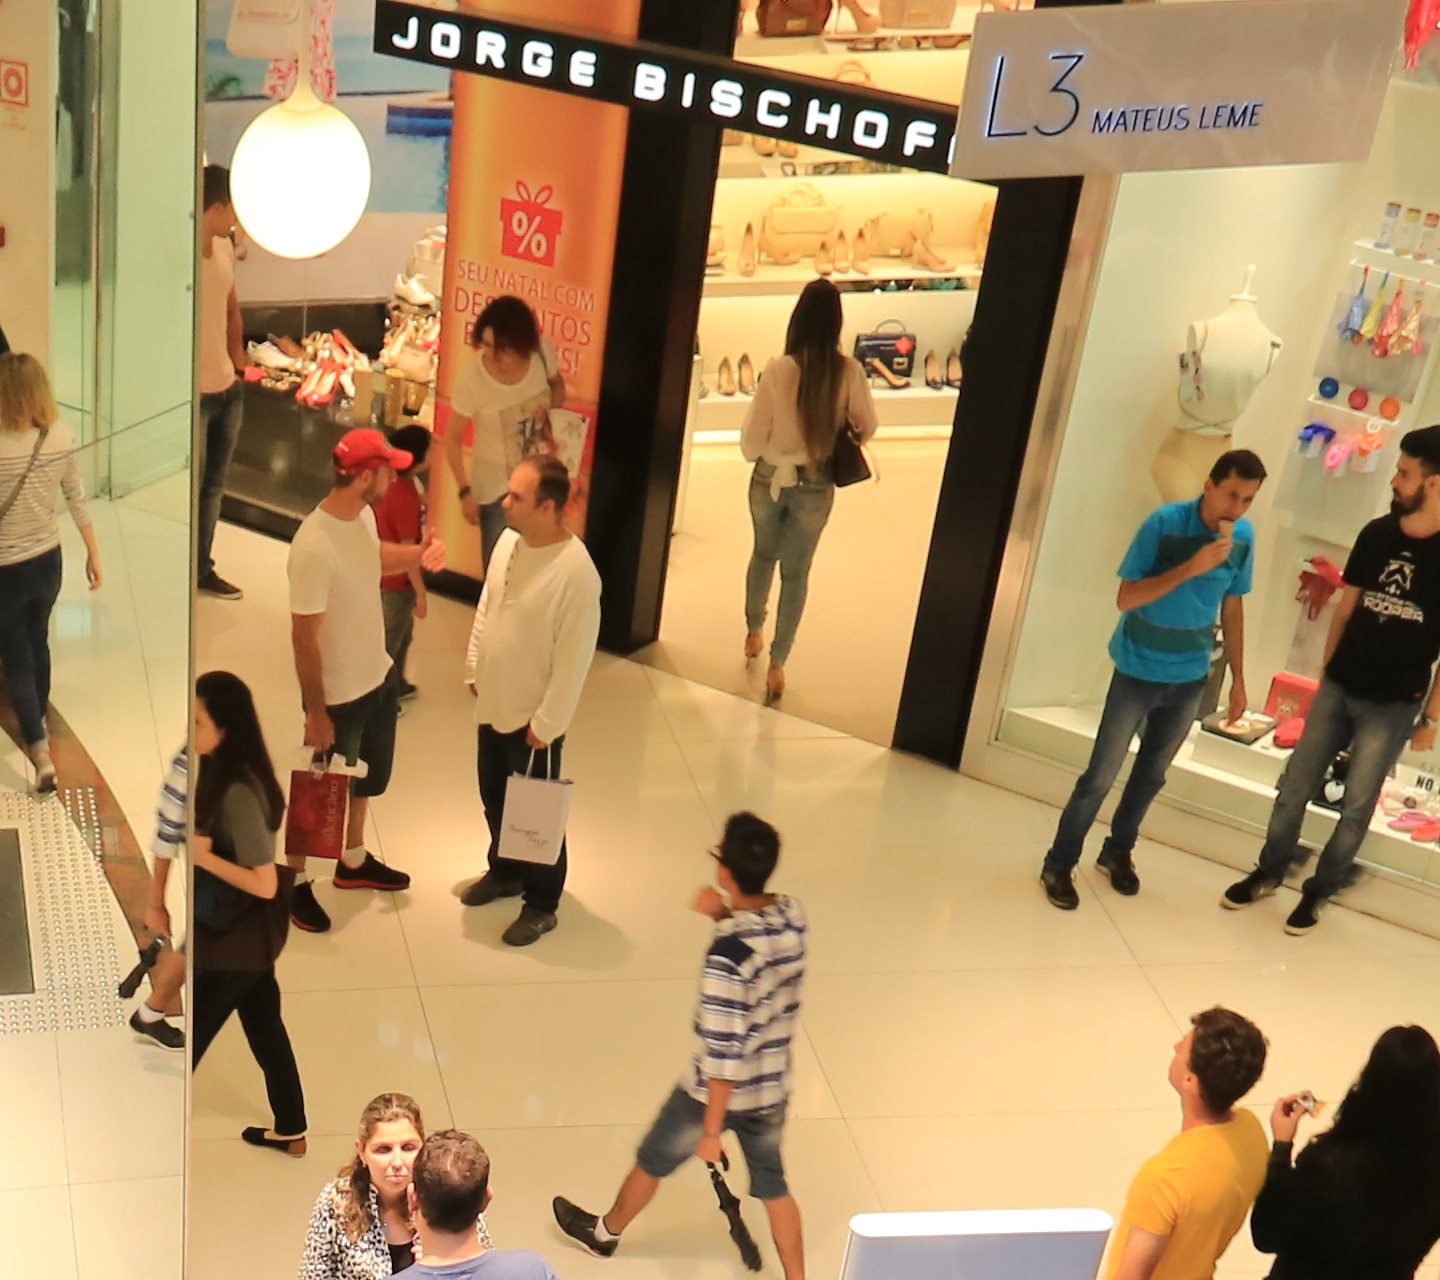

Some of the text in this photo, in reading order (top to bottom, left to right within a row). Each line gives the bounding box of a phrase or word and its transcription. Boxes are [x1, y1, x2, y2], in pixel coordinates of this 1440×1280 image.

[391, 16, 598, 88] JORGE
[986, 54, 1263, 137] L3 MATEUS LEME
[457, 260, 595, 313] SEU NATAL COM
[1415, 775, 1435, 792] NO
